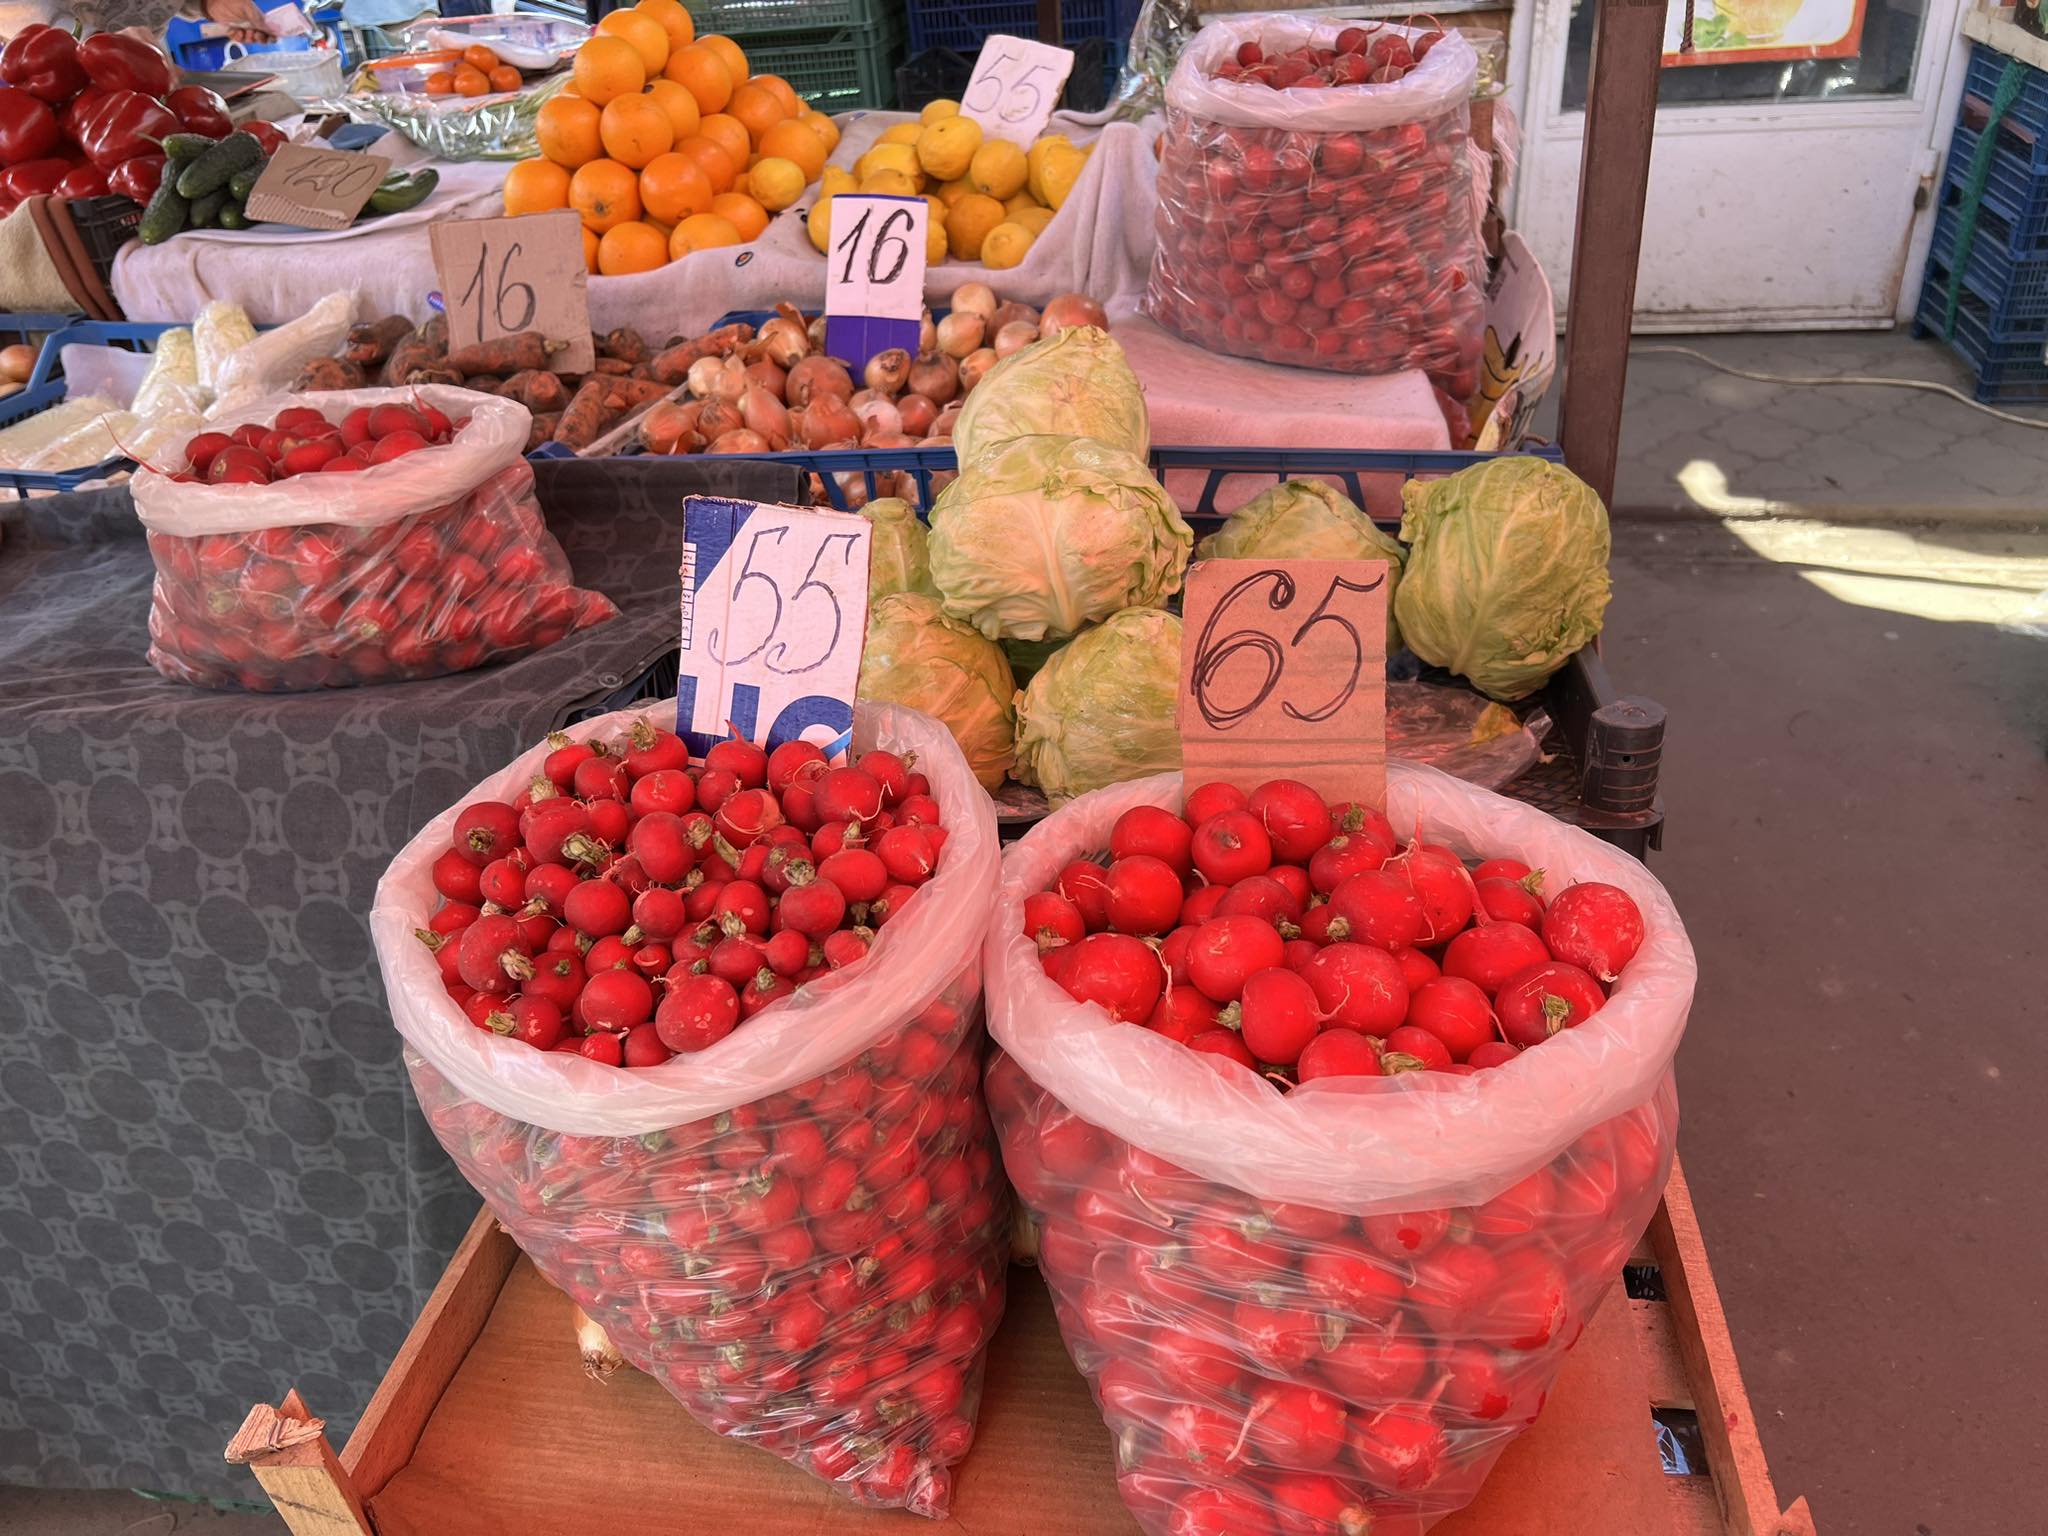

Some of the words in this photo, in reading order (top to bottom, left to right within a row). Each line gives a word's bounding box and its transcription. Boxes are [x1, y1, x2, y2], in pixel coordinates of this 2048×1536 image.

[965, 53, 1057, 123] 55
[283, 154, 377, 198] 120
[838, 208, 914, 284] 16
[461, 242, 536, 342] 16
[707, 526, 862, 675] 55
[1191, 569, 1385, 731] 65
